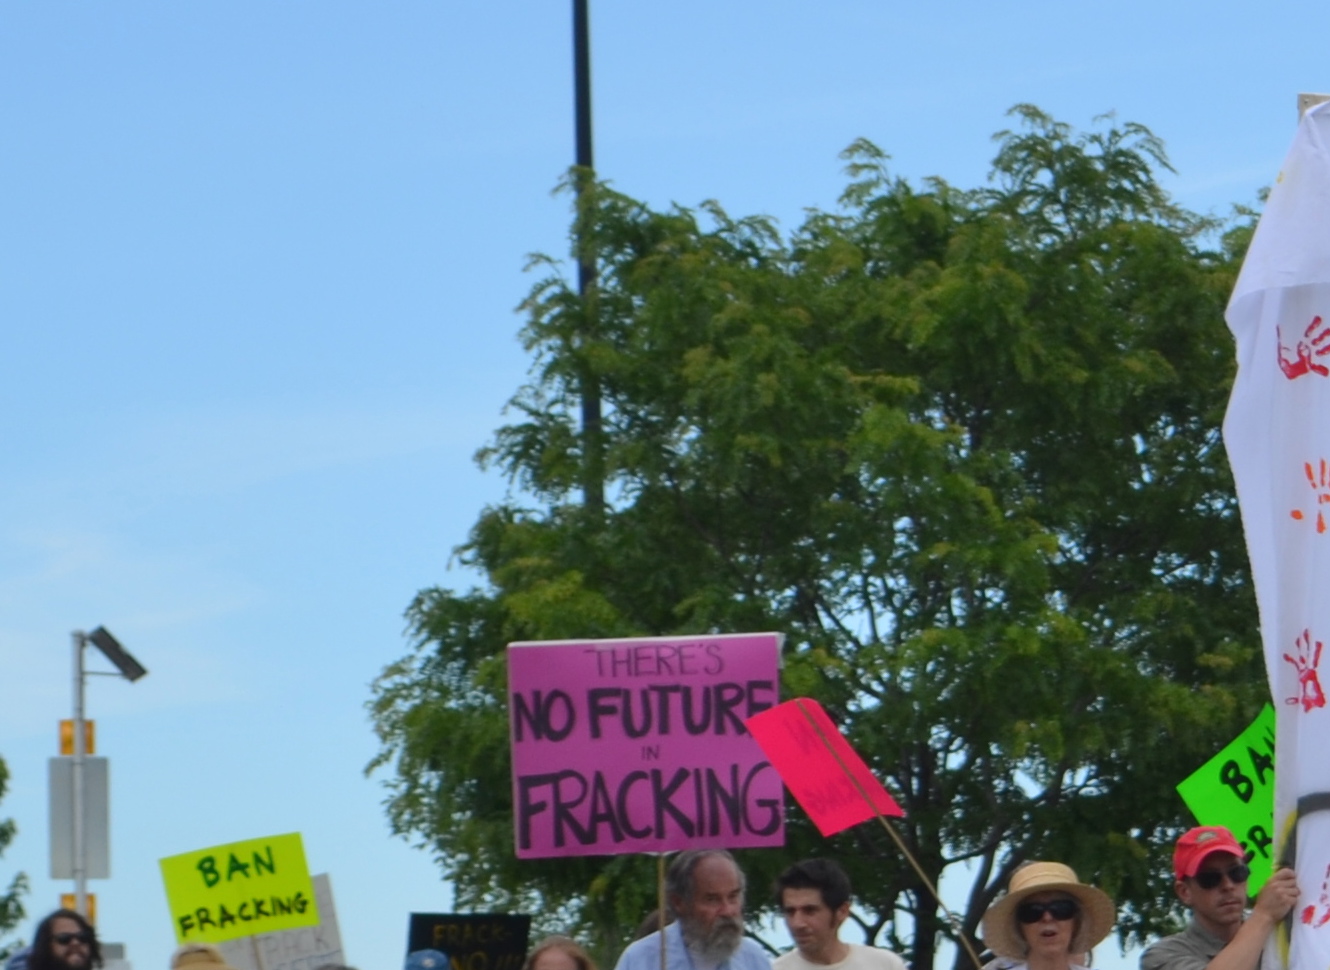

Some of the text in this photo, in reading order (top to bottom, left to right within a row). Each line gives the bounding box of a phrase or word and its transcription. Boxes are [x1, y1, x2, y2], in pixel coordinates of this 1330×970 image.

[584, 642, 725, 678] THERE'S
[512, 688, 577, 743] NO
[641, 744, 661, 761] IN
[517, 762, 782, 849] FRACKING
[196, 845, 276, 889] BAN
[177, 891, 310, 938] FRACKING
